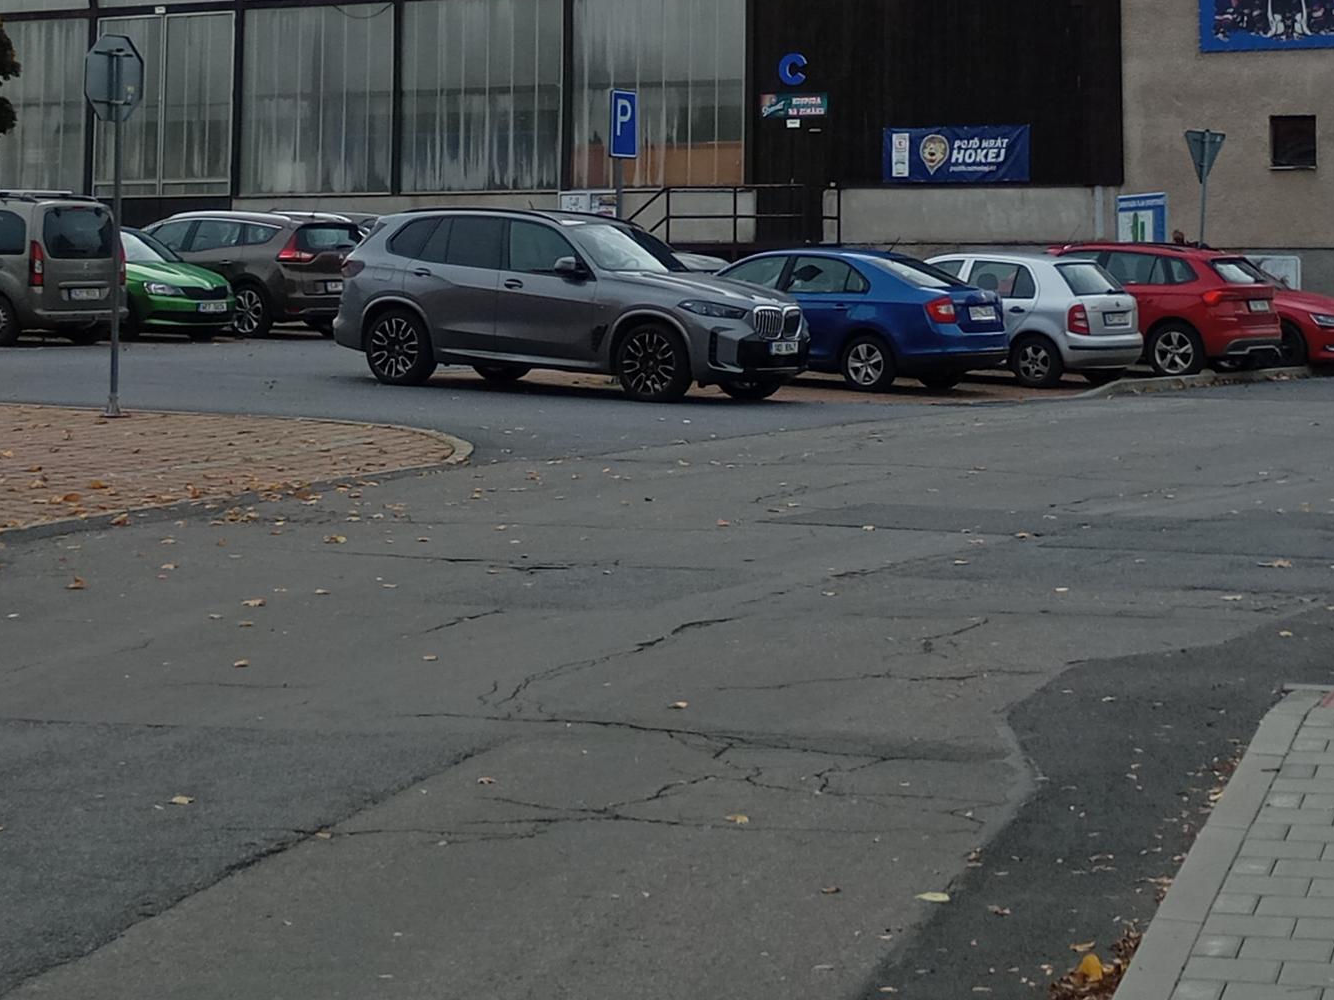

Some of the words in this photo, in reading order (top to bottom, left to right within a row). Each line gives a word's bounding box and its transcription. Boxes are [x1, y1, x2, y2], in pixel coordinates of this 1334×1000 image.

[778, 53, 808, 86] C
[617, 98, 632, 136] P
[982, 136, 1009, 148] HRÁT
[951, 148, 1007, 164] HOKEJ
